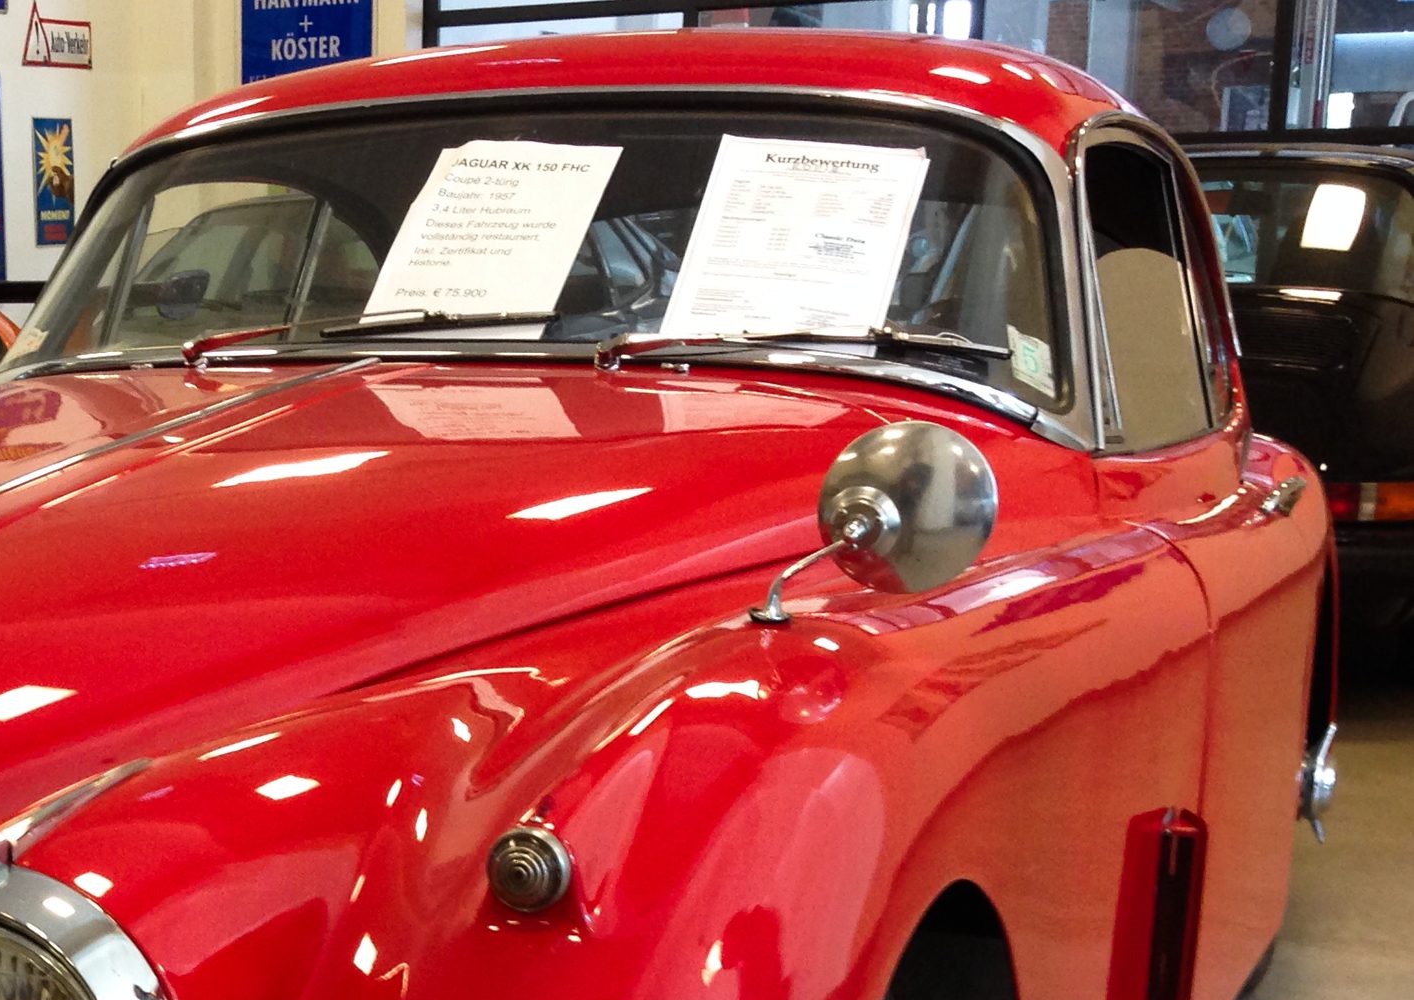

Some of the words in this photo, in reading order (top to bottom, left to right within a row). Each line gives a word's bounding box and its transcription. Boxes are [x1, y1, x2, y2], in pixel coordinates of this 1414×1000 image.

[271, 33, 340, 60] KÖSTER
[452, 158, 508, 169] JAGUAR
[512, 161, 531, 171] XK
[536, 163, 558, 172] 150
[561, 163, 591, 173] FHC
[765, 153, 880, 173] Kurzbewertung
[484, 176, 520, 187] 2-türig
[489, 192, 516, 200] 1957
[452, 206, 476, 214] Liter
[480, 206, 531, 214] Hubraum
[426, 218, 463, 228] Dieses
[466, 220, 519, 230] Fahrzeug
[522, 221, 557, 229] wurde
[421, 232, 479, 242] vollständig
[440, 247, 488, 256] Zertifikat
[490, 248, 512, 256] und
[433, 288, 443, 297] €
[445, 288, 488, 298] 75.900
